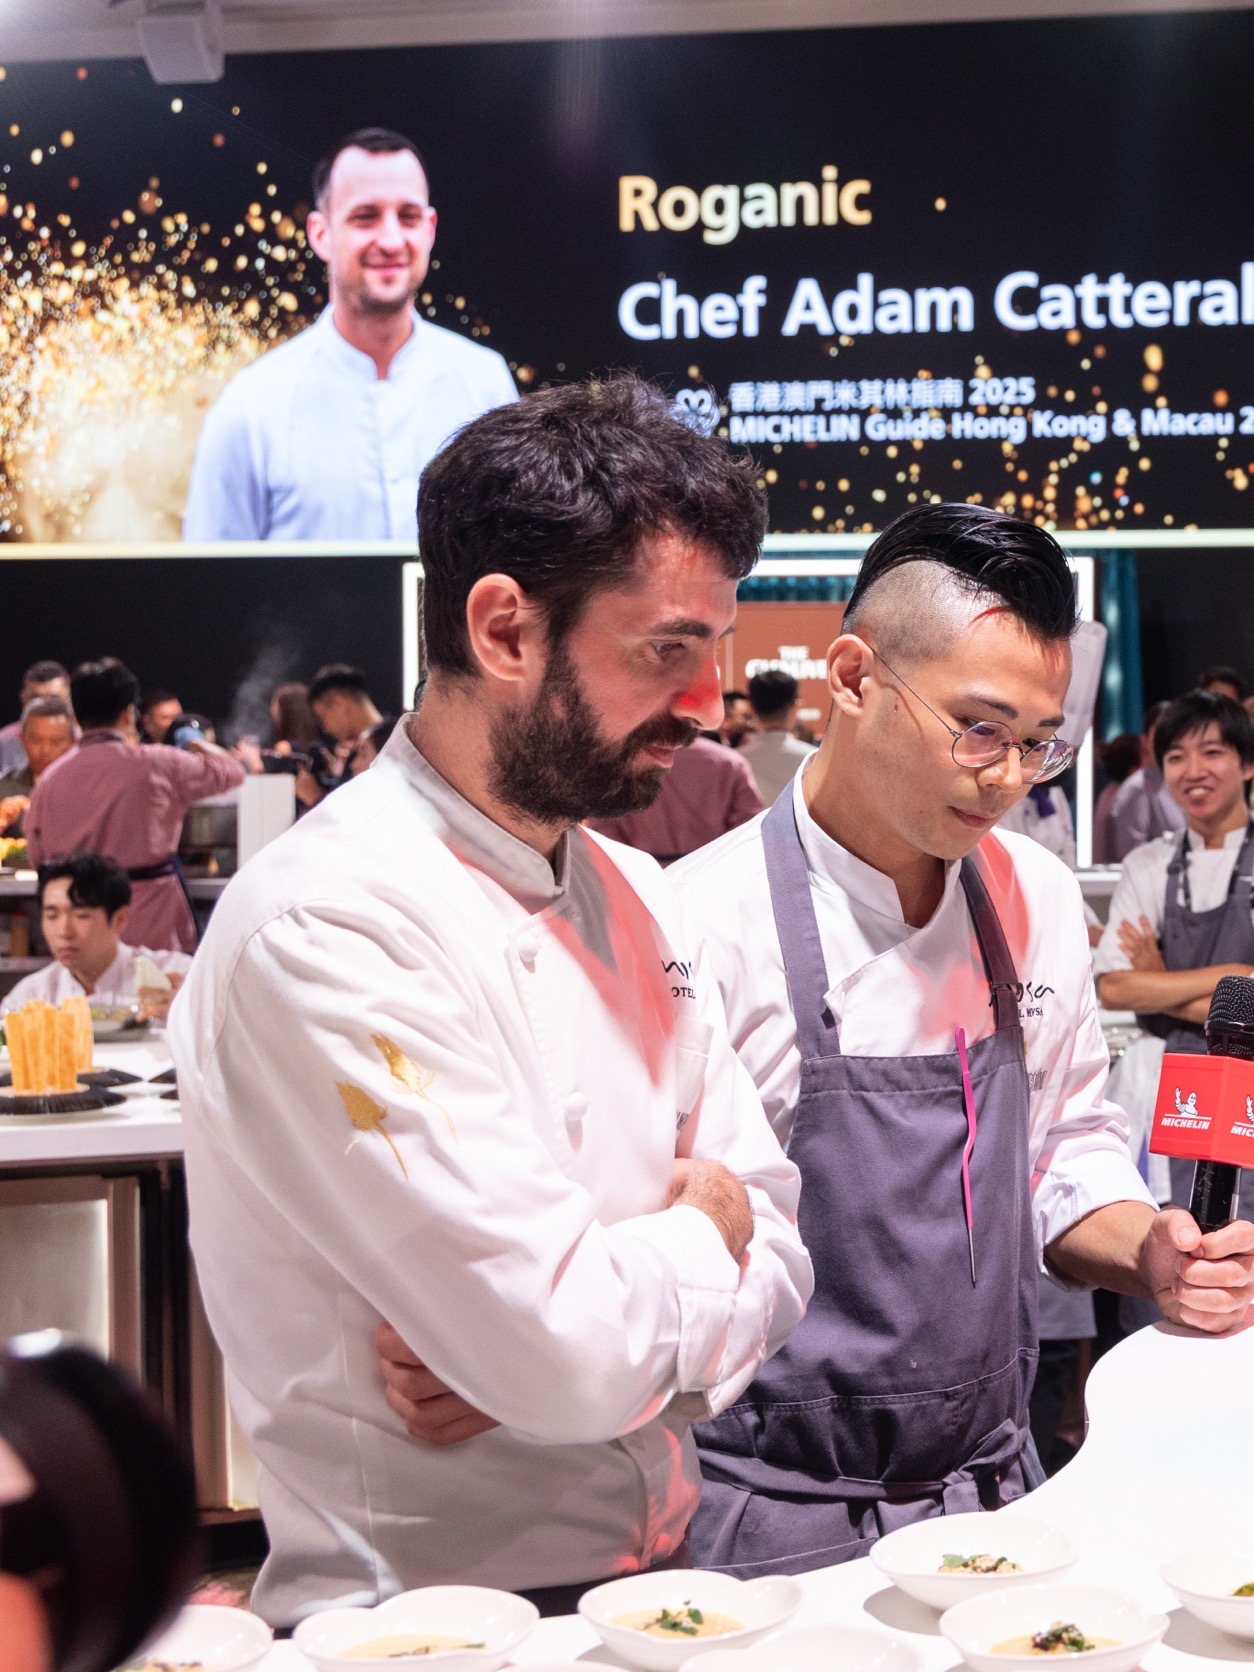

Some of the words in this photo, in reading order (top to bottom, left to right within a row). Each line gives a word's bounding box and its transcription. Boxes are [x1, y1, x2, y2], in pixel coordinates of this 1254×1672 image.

[618, 165, 872, 245] Roganic
[618, 275, 768, 340] Chef
[781, 273, 975, 337] Adam
[967, 377, 1036, 406] 2025
[729, 413, 861, 444] MICHELIN
[864, 411, 947, 442] Guide
[951, 411, 1027, 443] Hong
[1031, 409, 1107, 443] Kong
[1111, 408, 1137, 435] &
[1140, 407, 1235, 436] Macau
[1160, 1117, 1211, 1130] MICHELIN
